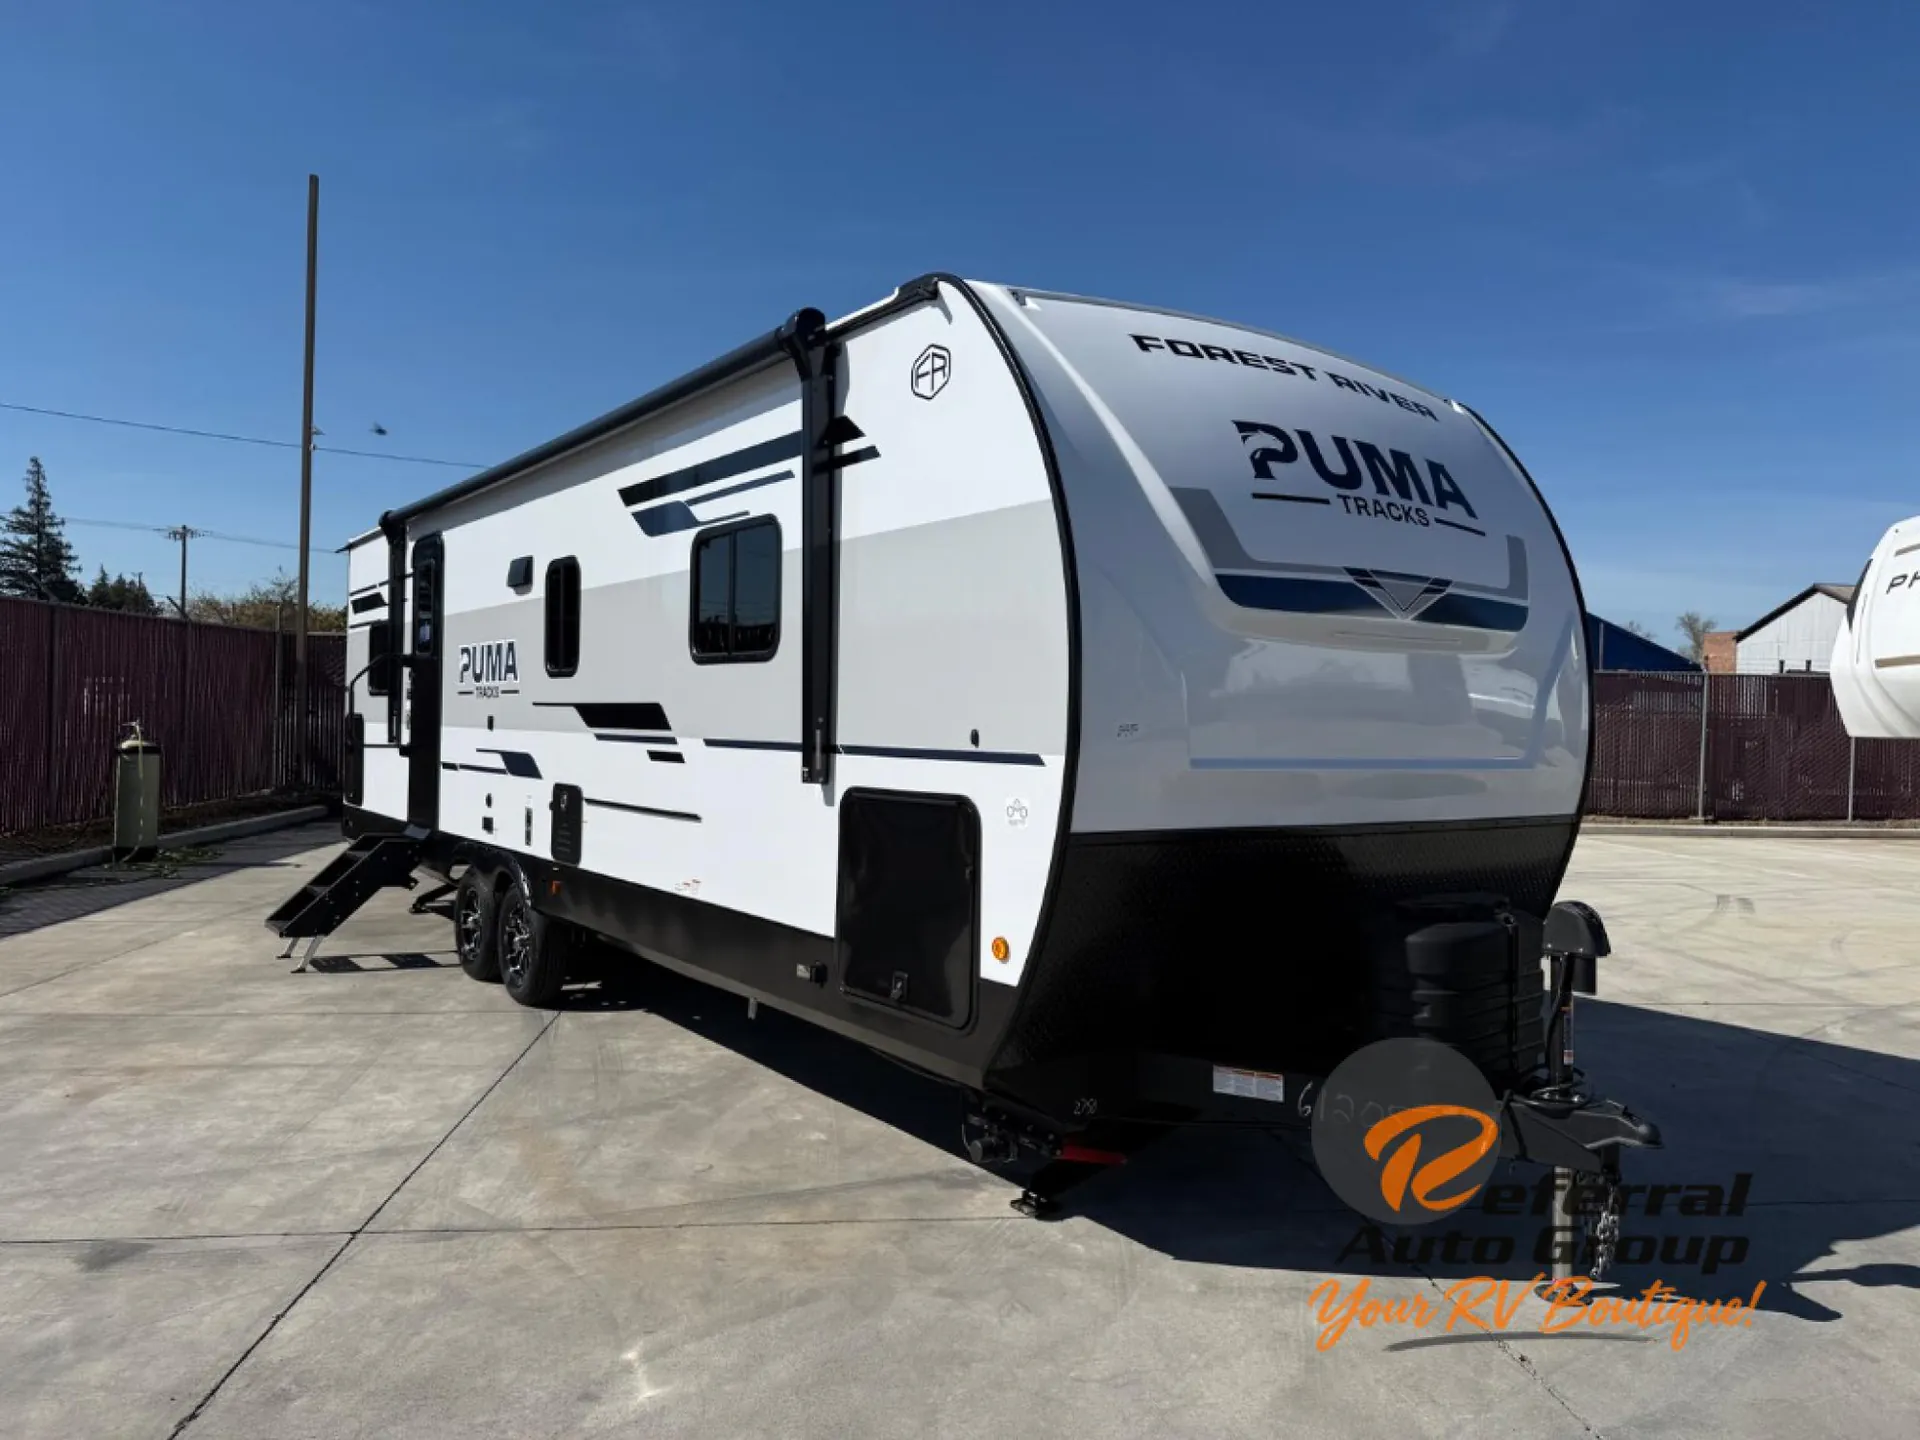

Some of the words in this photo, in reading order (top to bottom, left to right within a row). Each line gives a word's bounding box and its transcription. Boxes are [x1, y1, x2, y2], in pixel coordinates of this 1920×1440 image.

[1130, 333, 1317, 381] FOREST
[1325, 371, 1437, 420] RIVER
[1232, 419, 1479, 520] PUMA
[1337, 494, 1431, 528] TRACKS
[459, 640, 519, 684] PUMA
